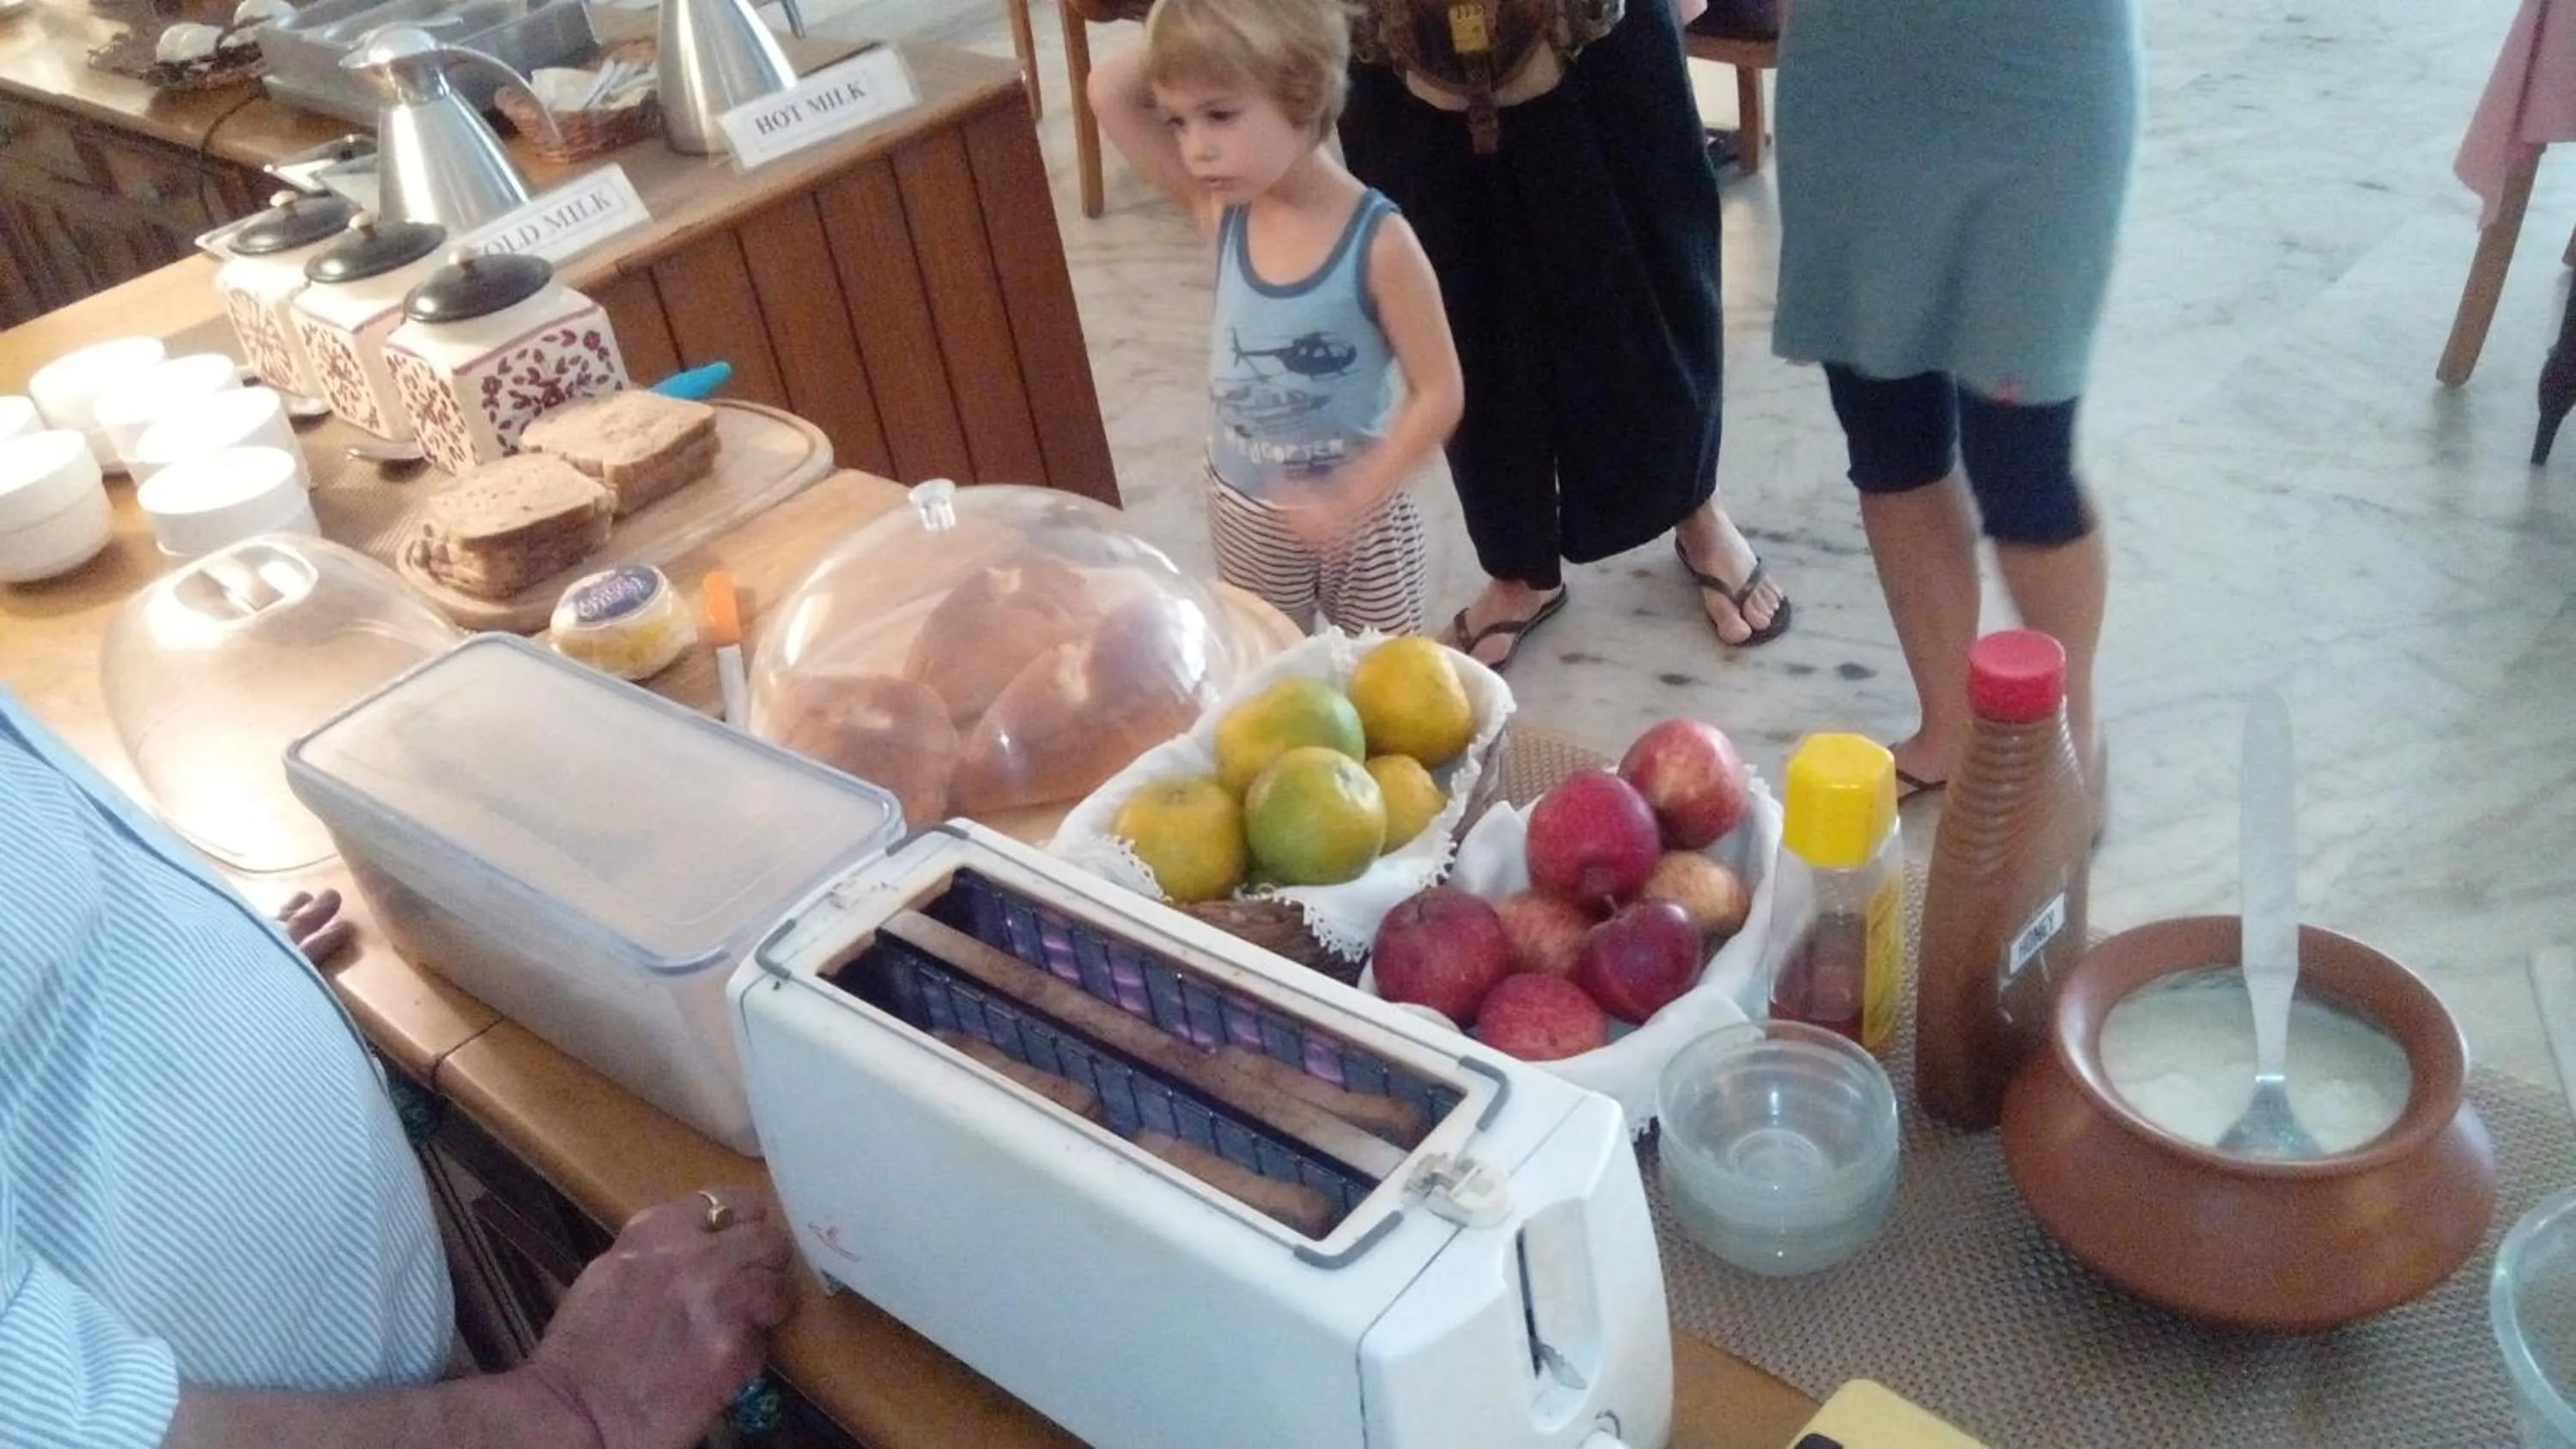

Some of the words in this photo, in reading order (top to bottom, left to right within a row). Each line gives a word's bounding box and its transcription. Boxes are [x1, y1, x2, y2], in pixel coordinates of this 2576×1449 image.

[755, 103, 804, 136] HOT
[805, 83, 866, 114] MILK
[483, 224, 541, 256] OLD
[543, 190, 612, 231] MILK
[2018, 909, 2056, 961] HONEY
